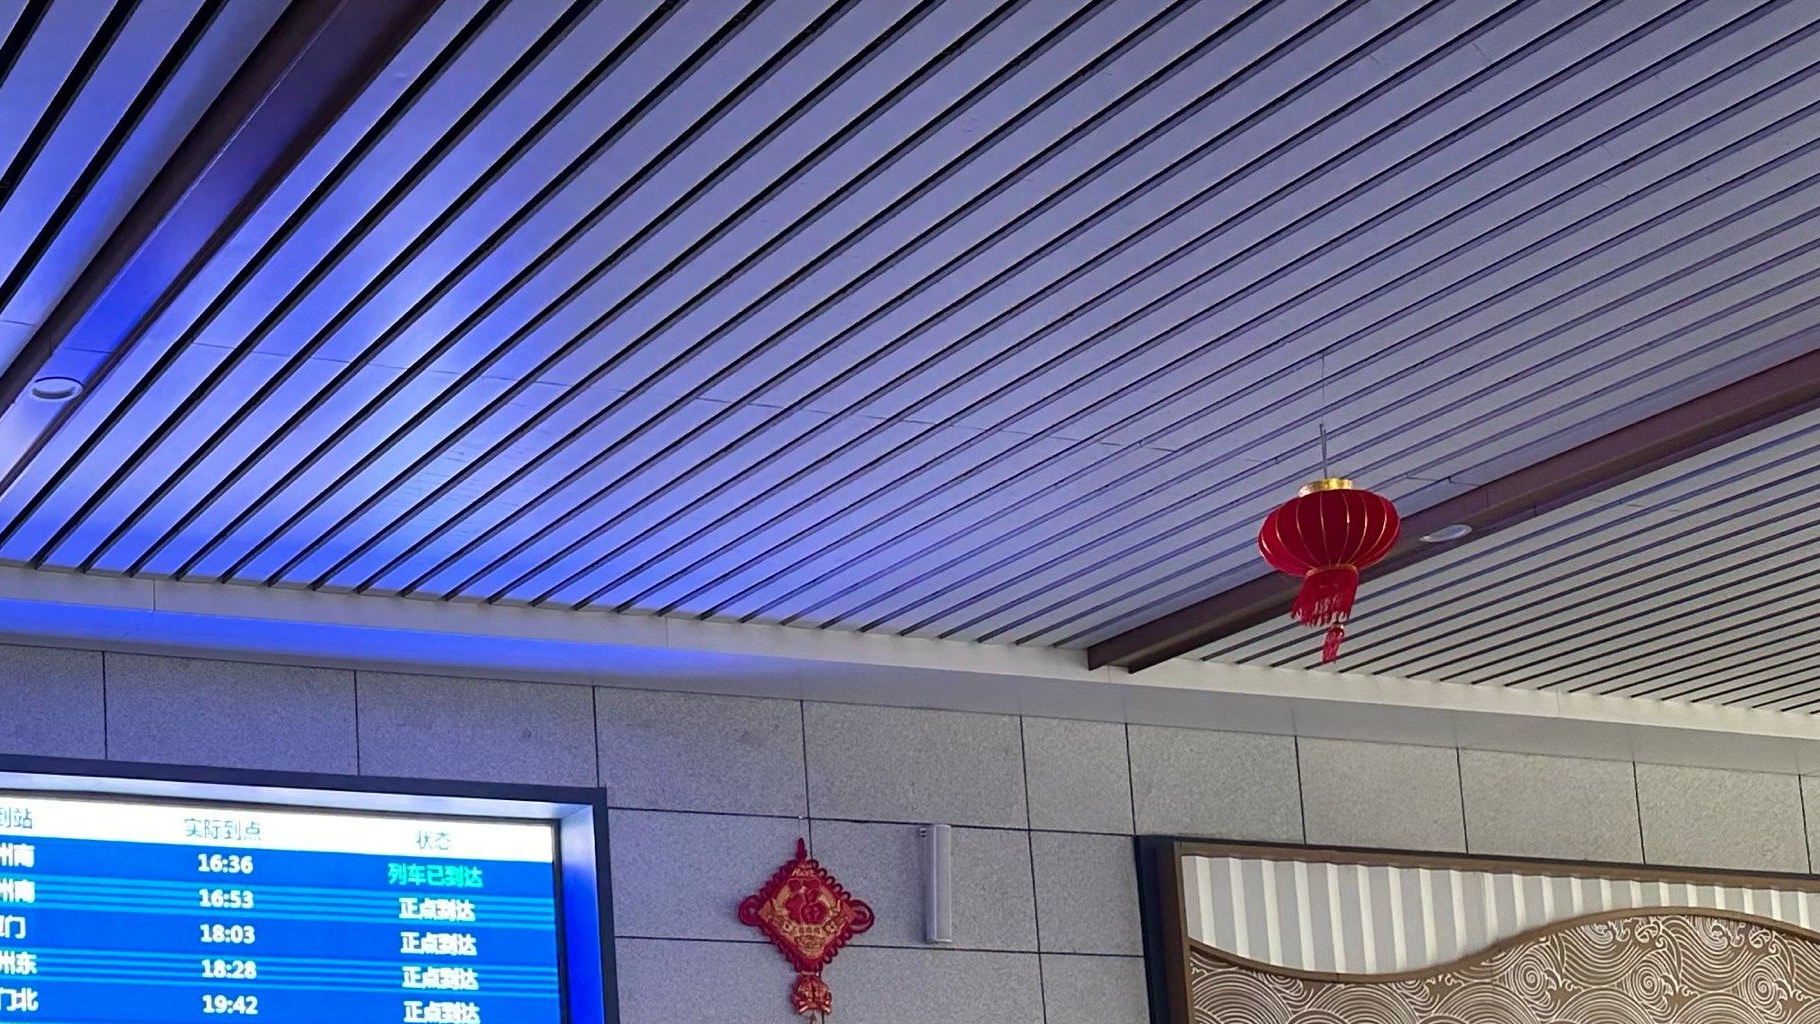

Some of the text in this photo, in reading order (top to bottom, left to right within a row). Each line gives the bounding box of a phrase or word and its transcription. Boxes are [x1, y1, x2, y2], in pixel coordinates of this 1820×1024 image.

[184, 816, 262, 843] 实际到点
[415, 828, 451, 851] 状态
[198, 853, 254, 875] 16:36
[388, 862, 483, 889] 列车已到达
[199, 888, 254, 910] 16:53
[398, 898, 476, 923] 正点到达
[199, 923, 255, 946] 18:03
[400, 931, 477, 957] 正点到达
[200, 958, 256, 981] 18:28
[401, 966, 479, 992] 正点到达
[202, 994, 258, 1016] 19:42
